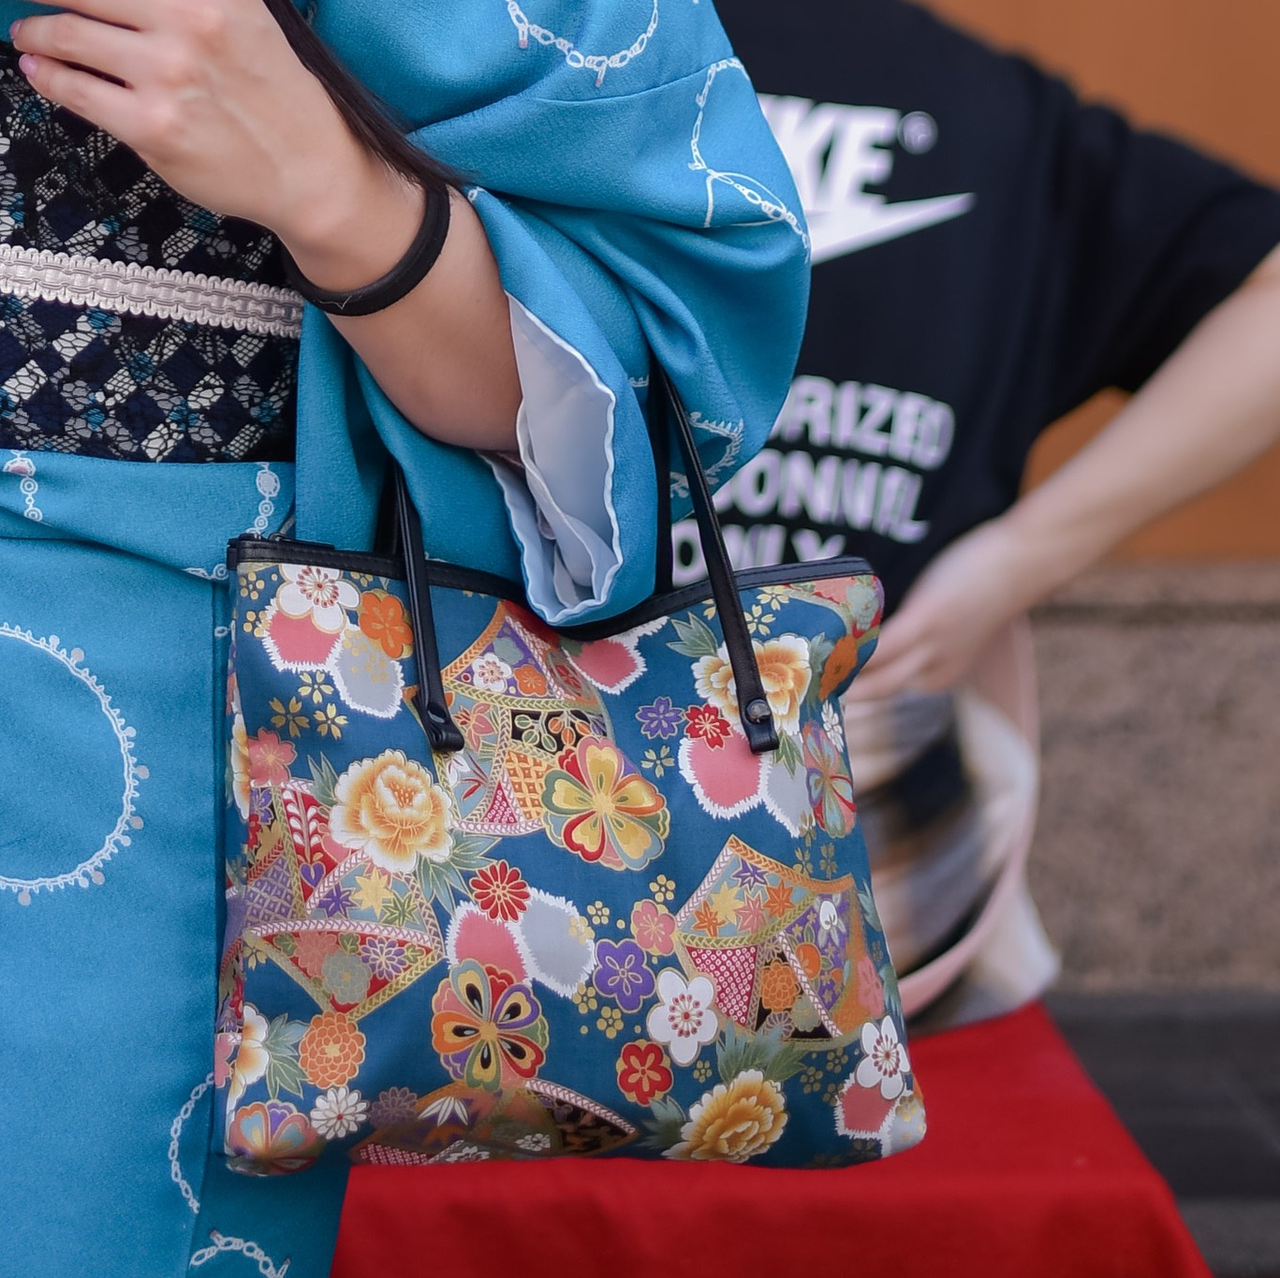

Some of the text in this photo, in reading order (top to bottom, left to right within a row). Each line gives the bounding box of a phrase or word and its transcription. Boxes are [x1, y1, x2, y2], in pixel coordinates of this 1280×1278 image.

[757, 92, 902, 211] KE
[770, 374, 956, 471] RIZED
[713, 447, 931, 544] ONNEL
